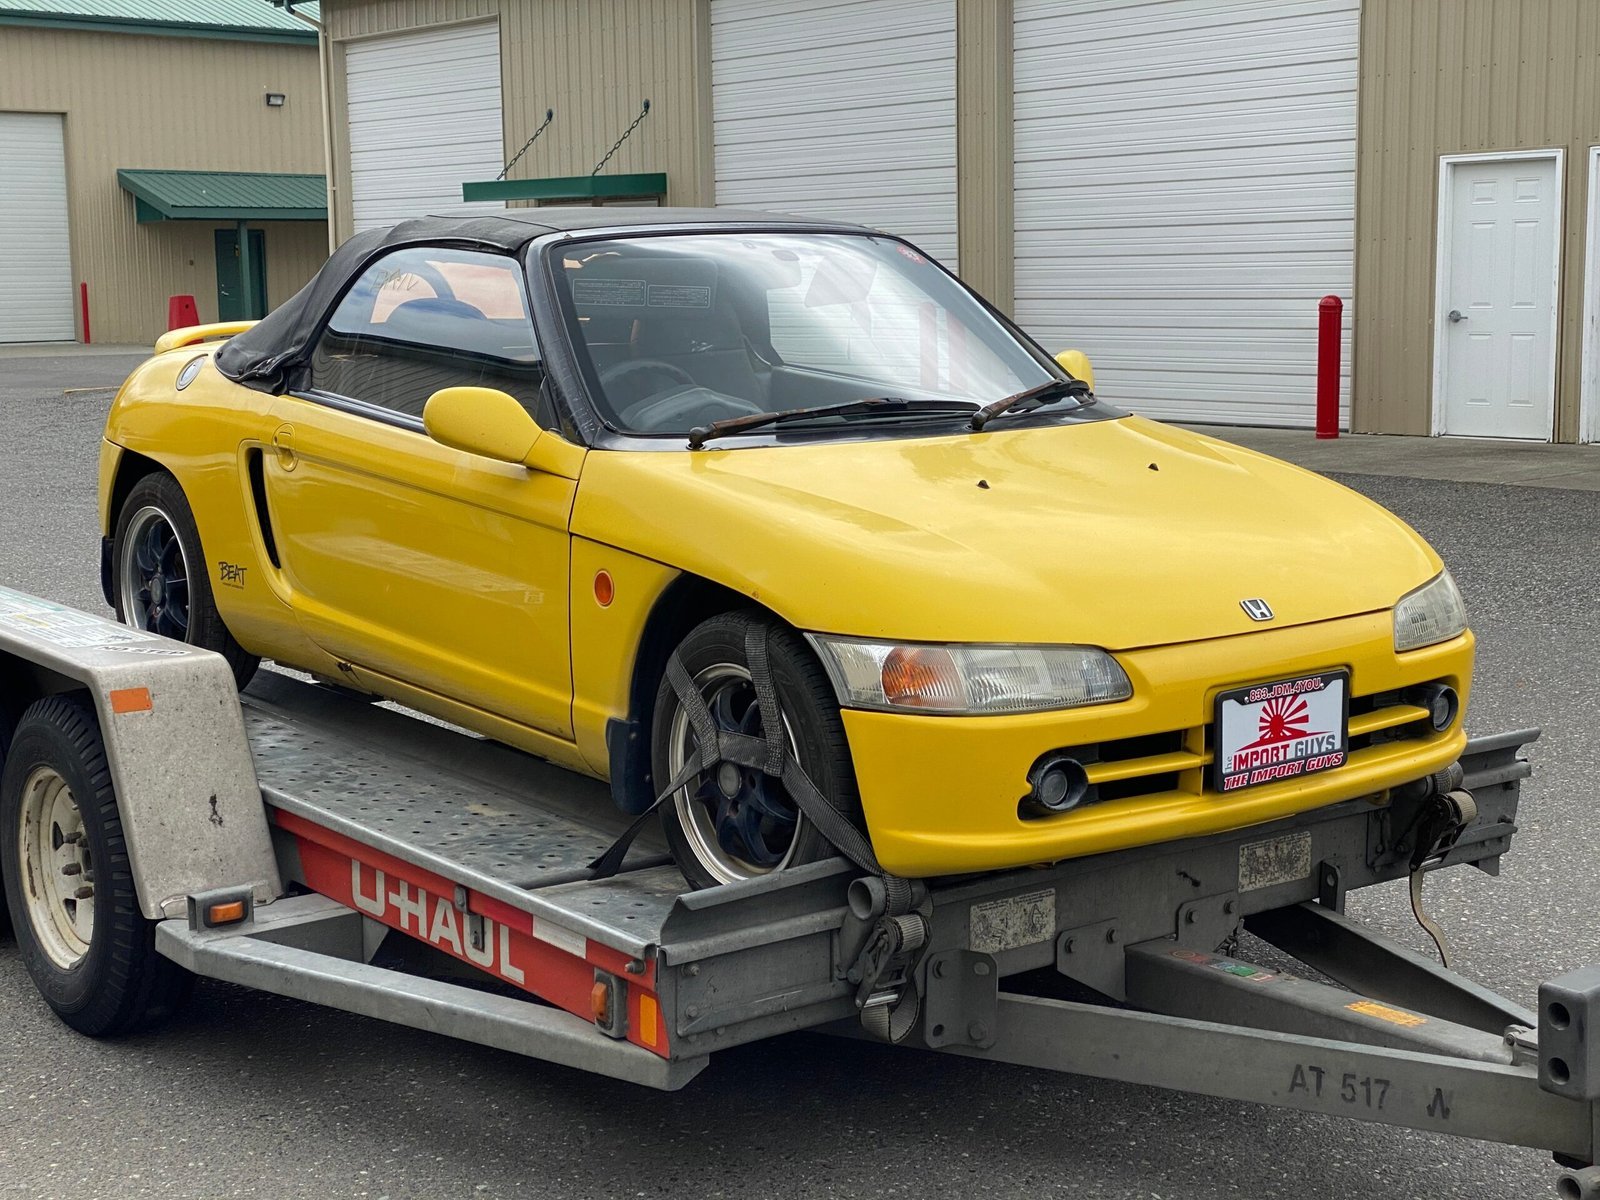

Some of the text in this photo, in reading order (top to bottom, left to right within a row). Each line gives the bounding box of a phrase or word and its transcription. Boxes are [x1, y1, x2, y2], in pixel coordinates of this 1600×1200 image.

[218, 561, 248, 586] BEAT
[1224, 752, 1343, 791] THE IMPORT GUYS
[1233, 734, 1336, 772] IMPORT GUYS
[352, 858, 525, 985] U-HAUL
[1288, 1063, 1325, 1097] AT
[1340, 1072, 1390, 1111] 517
